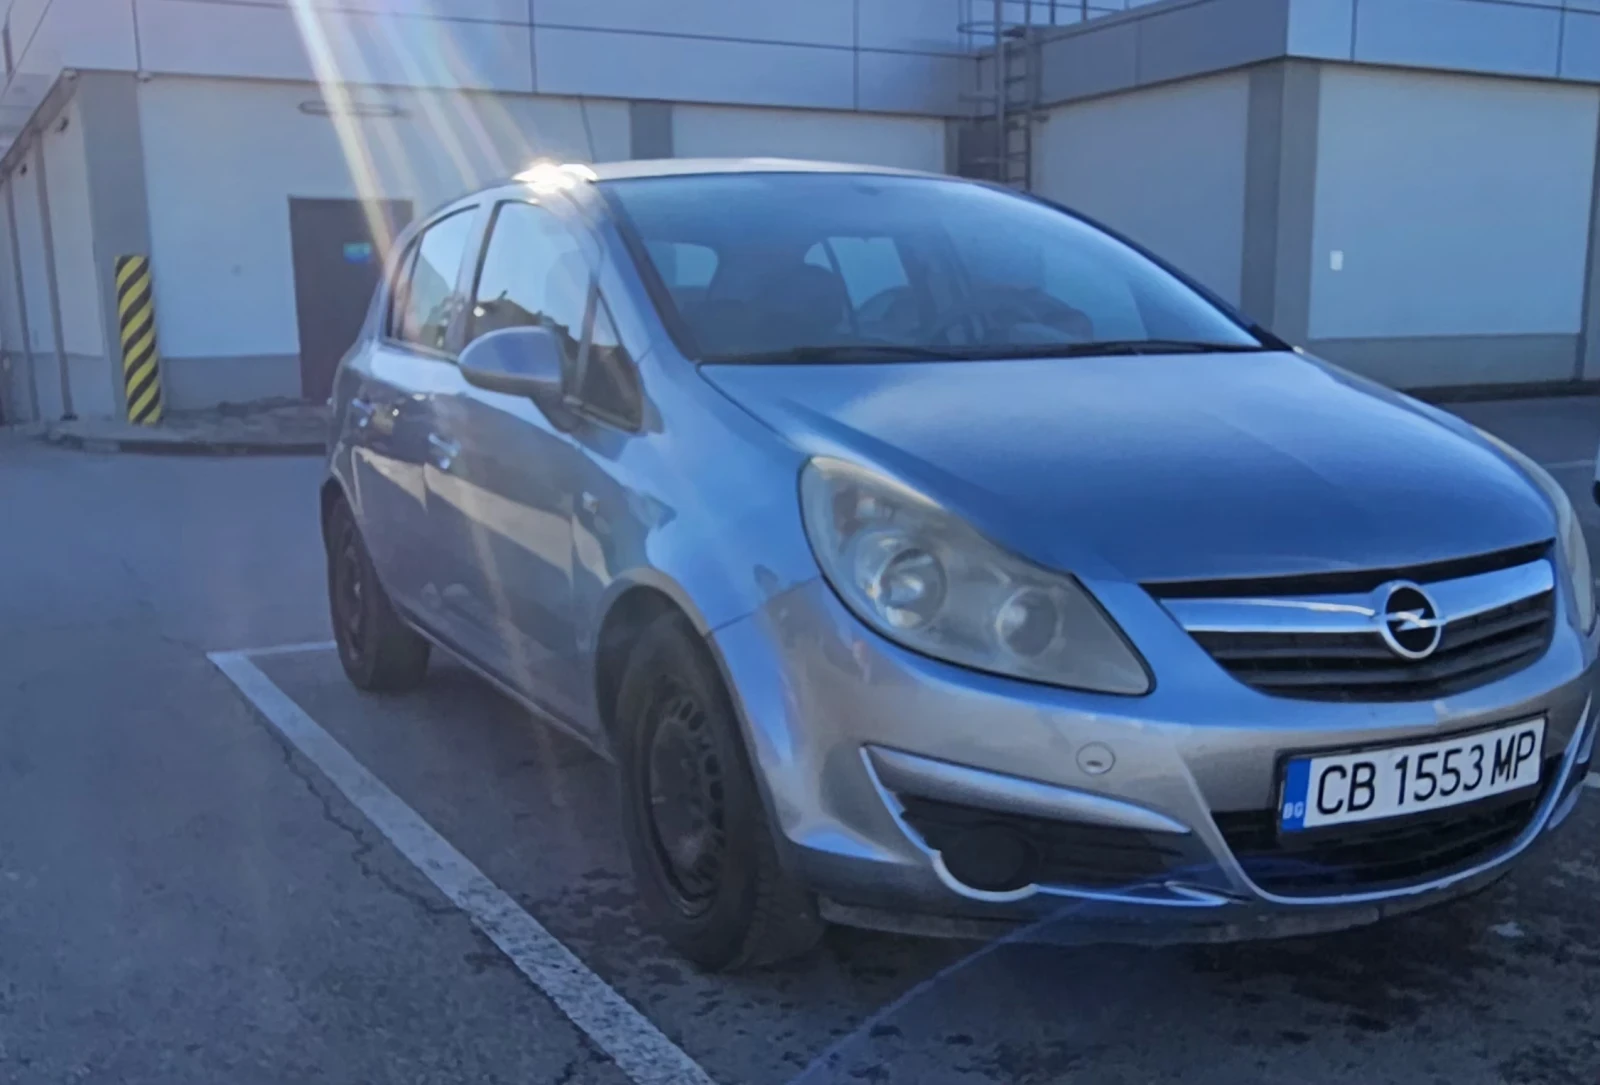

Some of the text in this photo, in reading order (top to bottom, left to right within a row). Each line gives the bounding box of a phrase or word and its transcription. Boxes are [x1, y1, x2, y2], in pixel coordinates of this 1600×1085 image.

[1316, 730, 1535, 815] CB 1553 MP
[1282, 801, 1304, 820] BG
